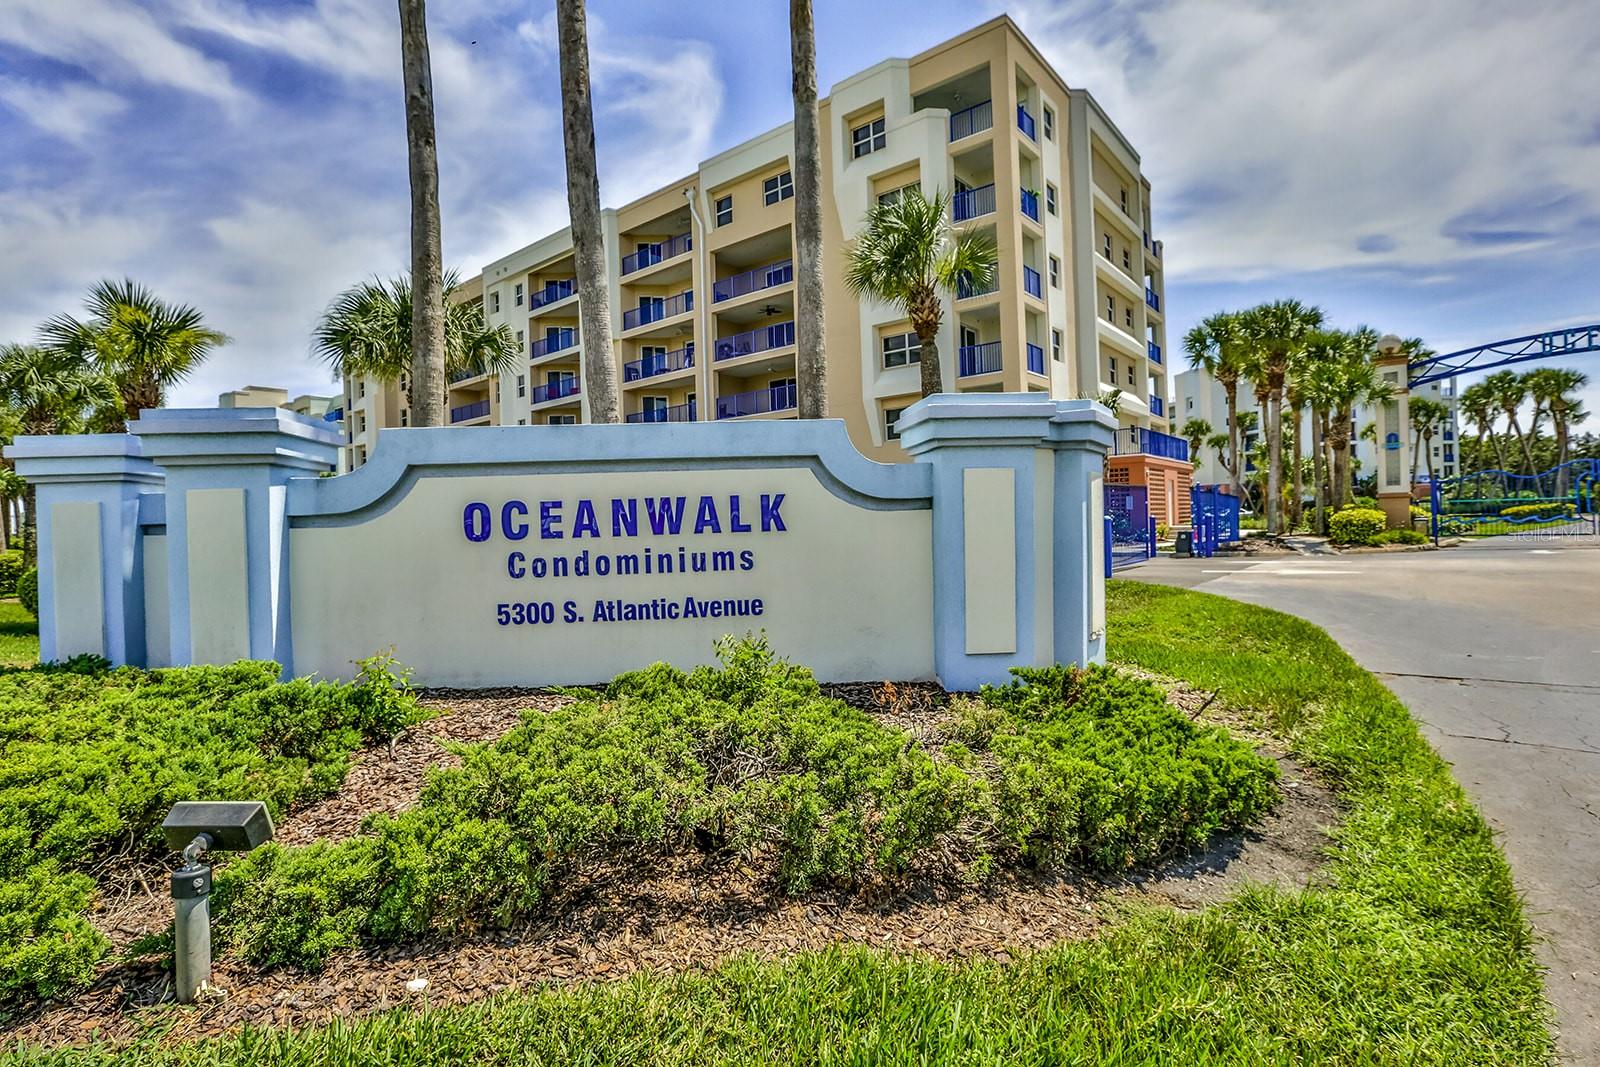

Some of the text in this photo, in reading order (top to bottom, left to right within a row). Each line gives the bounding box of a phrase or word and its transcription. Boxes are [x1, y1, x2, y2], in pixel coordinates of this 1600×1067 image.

[463, 493, 788, 543] OCEANWALK
[507, 546, 754, 579] Condominiums
[497, 596, 764, 626] 5300 S. Atlantic Avenue
